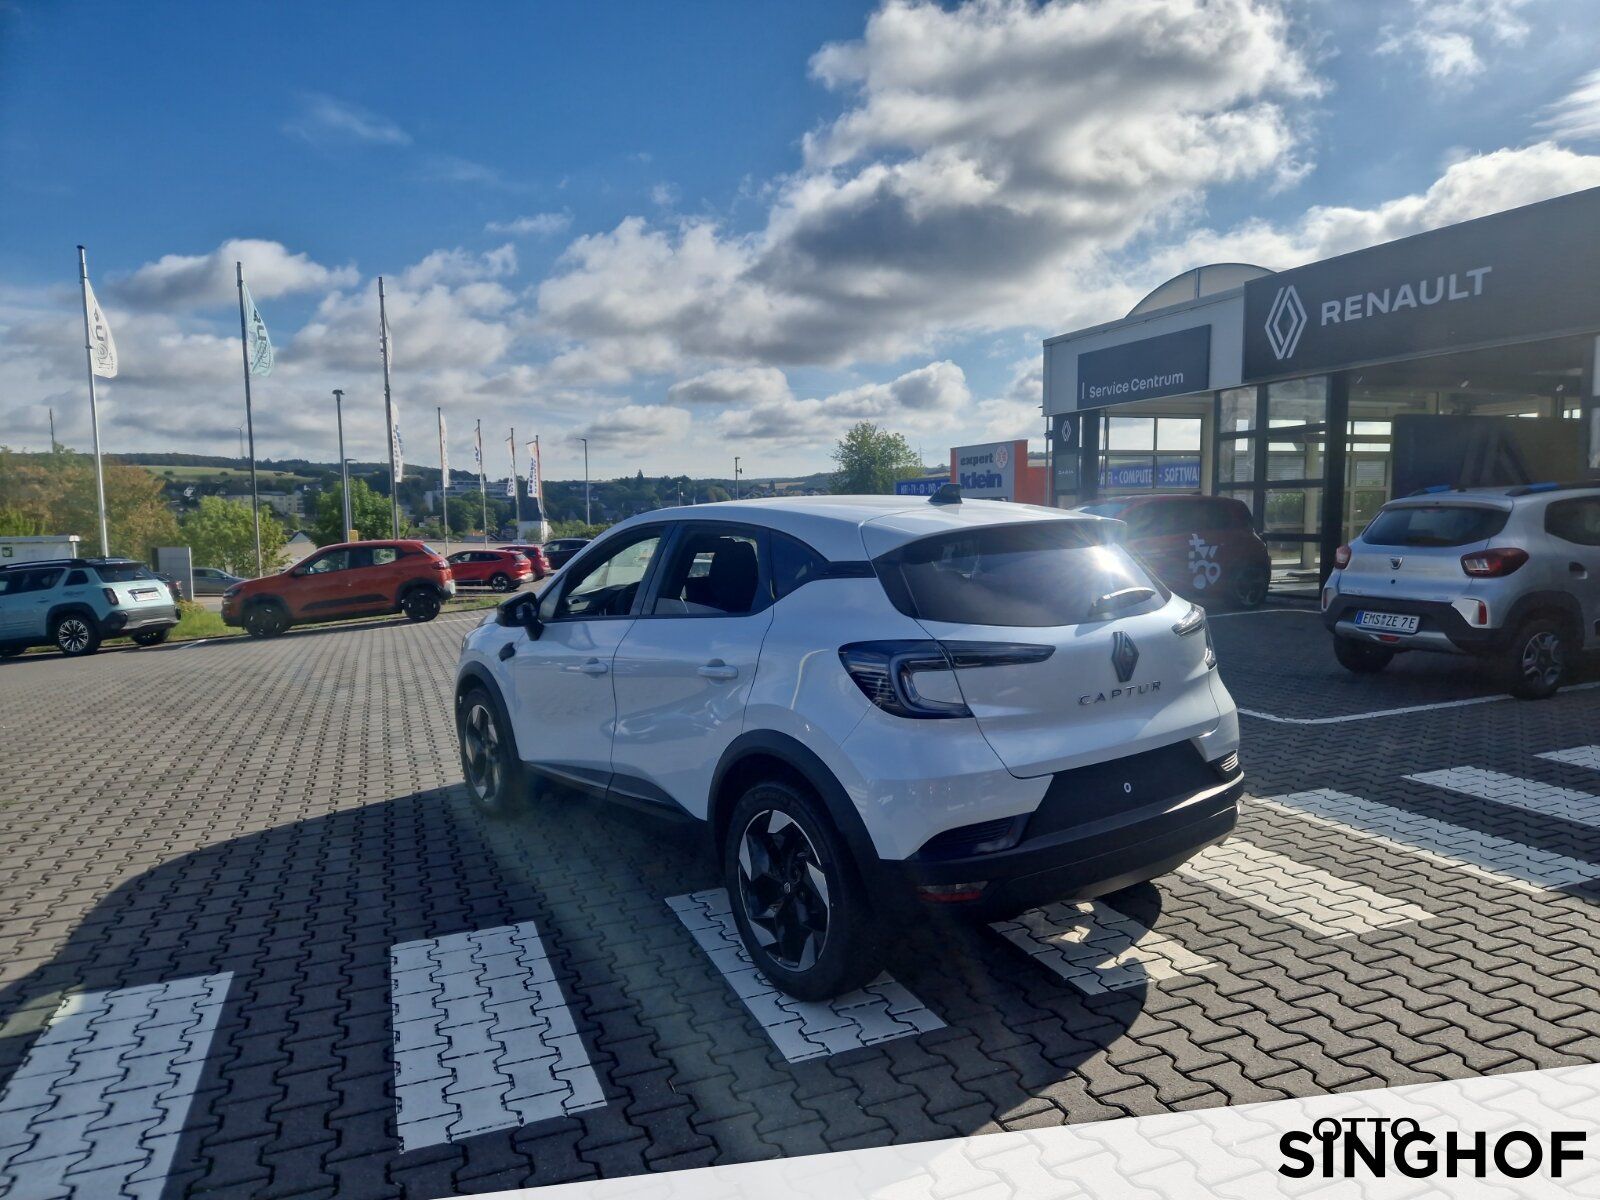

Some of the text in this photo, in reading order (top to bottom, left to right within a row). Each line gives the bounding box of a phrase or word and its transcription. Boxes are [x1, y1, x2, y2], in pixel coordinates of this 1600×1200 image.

[1321, 266, 1492, 326] RENAULT
[1089, 370, 1184, 399] Service Centrum
[960, 453, 994, 467] expert
[960, 470, 1002, 490] klein
[1118, 469, 1153, 484] COMPUTE
[1363, 613, 1380, 625] EMS
[1386, 616, 1397, 627] ZE
[1078, 680, 1161, 705] CAPTUR
